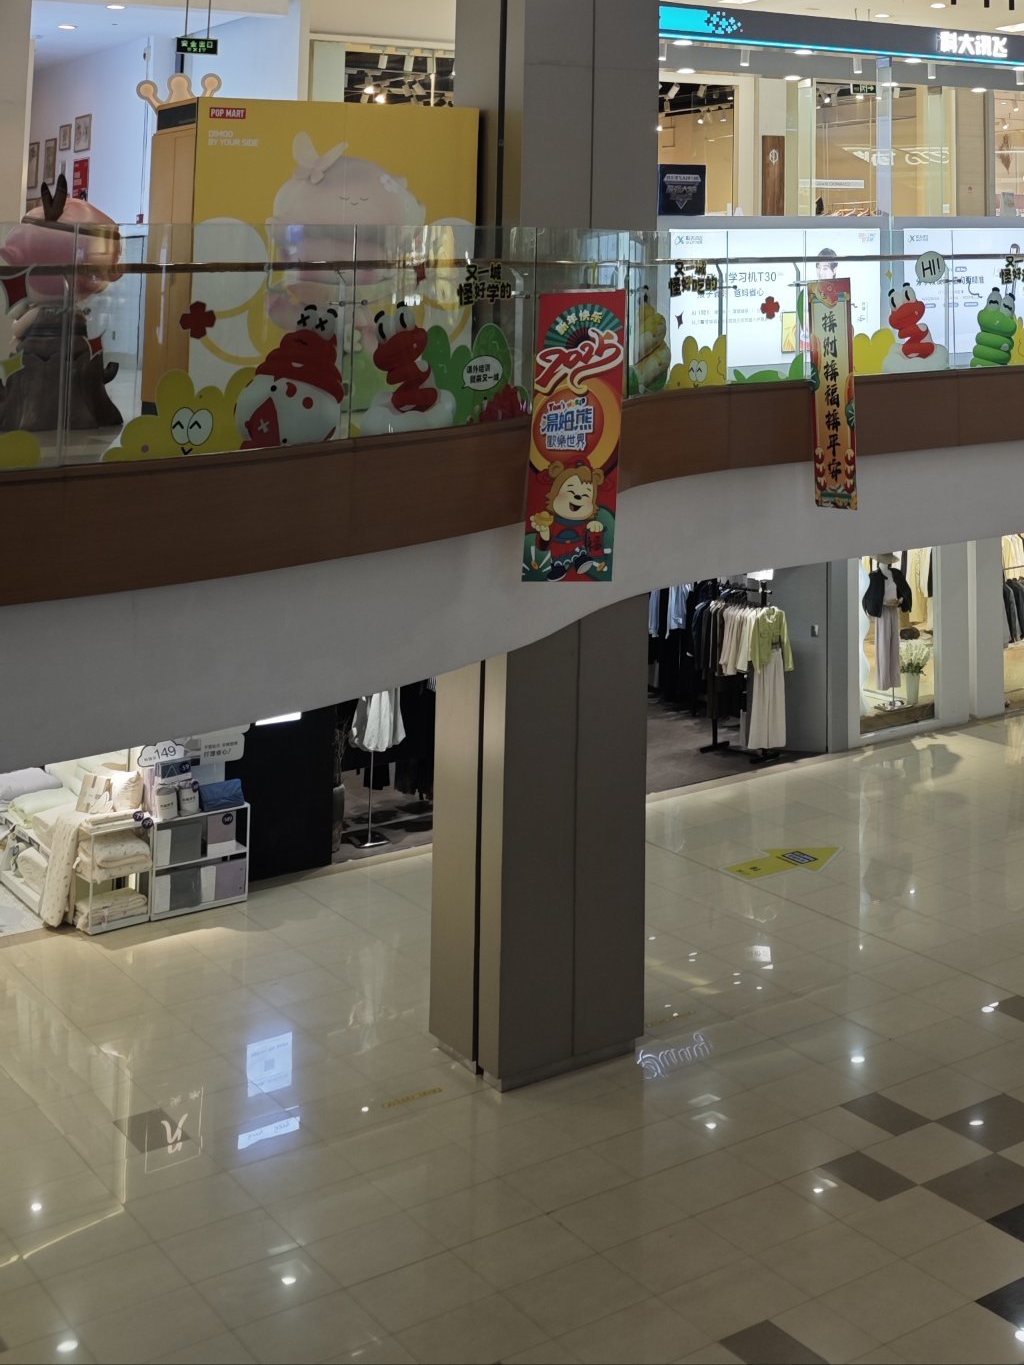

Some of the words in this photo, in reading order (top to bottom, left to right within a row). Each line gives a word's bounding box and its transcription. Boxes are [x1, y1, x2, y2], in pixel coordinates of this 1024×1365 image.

[935, 31, 1008, 58] 科大讯飞
[210, 108, 225, 117] POP
[225, 109, 245, 118] MART
[465, 264, 502, 281] 又一城
[457, 283, 512, 306] 怪好学的
[155, 745, 177, 759] 149
